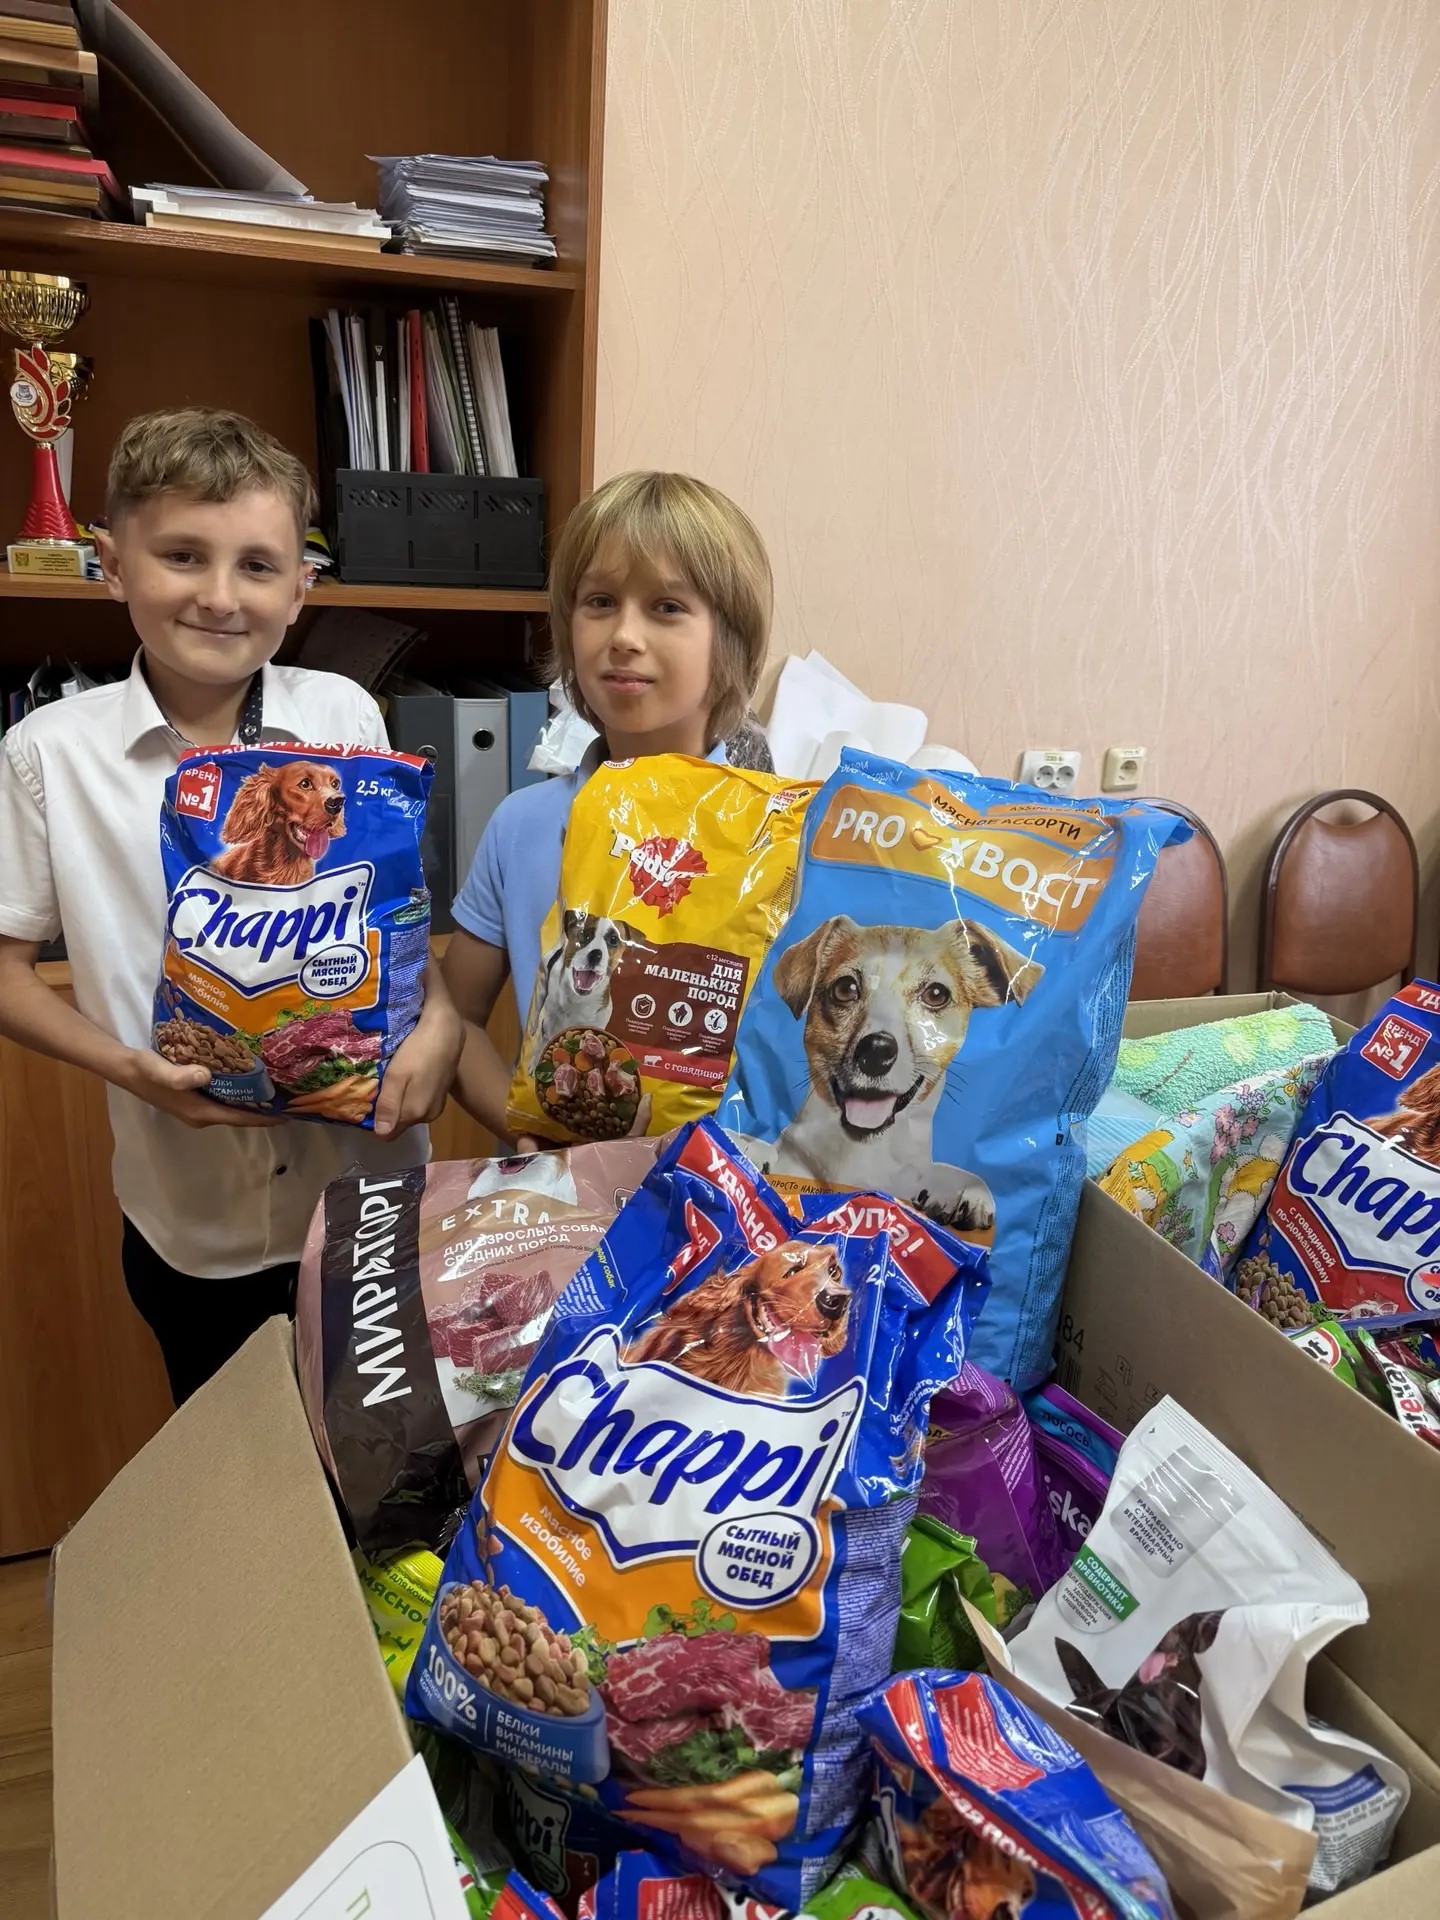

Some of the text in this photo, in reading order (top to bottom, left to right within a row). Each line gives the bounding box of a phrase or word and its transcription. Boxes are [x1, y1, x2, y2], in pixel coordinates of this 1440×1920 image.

[356, 779, 394, 797] 2,5 кг
[832, 807, 906, 849] PRO
[933, 795, 1082, 841] МЯСНОЕ АССОРТИ
[941, 837, 1100, 909] ХВОСТ
[167, 885, 359, 962] Chappi
[311, 964, 357, 979] МЯСНОЙ
[312, 952, 358, 968] СЫТНЫЙ
[711, 963, 743, 981] ДЛЯ
[319, 976, 349, 988] ОБЕД
[644, 964, 741, 995] МАЛЕНЬКИХ
[687, 986, 738, 1011] ПОРОД
[210, 1078, 233, 1087] ЕЛКИ
[672, 1063, 724, 1080] говядиной
[703, 1146, 778, 1252] Удачна
[771, 1179, 799, 1190] ПРОСТО
[442, 1199, 551, 1232] EXTRA
[444, 1238, 473, 1258] ДЛЯ
[518, 1234, 571, 1254] ПОРОД
[1275, 1208, 1331, 1285] по-домашнему
[1296, 1212, 1336, 1269] говядиной
[352, 1178, 413, 1408] МИРАТОРГ
[511, 1360, 840, 1515] Chappi
[724, 1524, 801, 1551] СЫТНЫЙ
[1123, 1508, 1174, 1565] ВЕТЕРИНАРНЫХ
[1136, 1498, 1184, 1550] РАЗРАБОТАНО
[1140, 1513, 1175, 1554] УЧАСТИЕМ
[519, 1511, 586, 1588] изобилие
[717, 1542, 795, 1570] МЯСНОЙ
[726, 1563, 774, 1589] ОБЕД
[1075, 1559, 1125, 1613] ПРЕБИОТИКИ
[1087, 1556, 1128, 1601] СОДЕРЖИТ
[360, 1568, 428, 1626] МЯСНО
[428, 1644, 478, 1721] 100%
[496, 1710, 540, 1738] БЕЛКИ
[495, 1726, 573, 1762] ВИТАМИНЫ
[495, 1739, 571, 1776] МИНЕРАЛЫ
